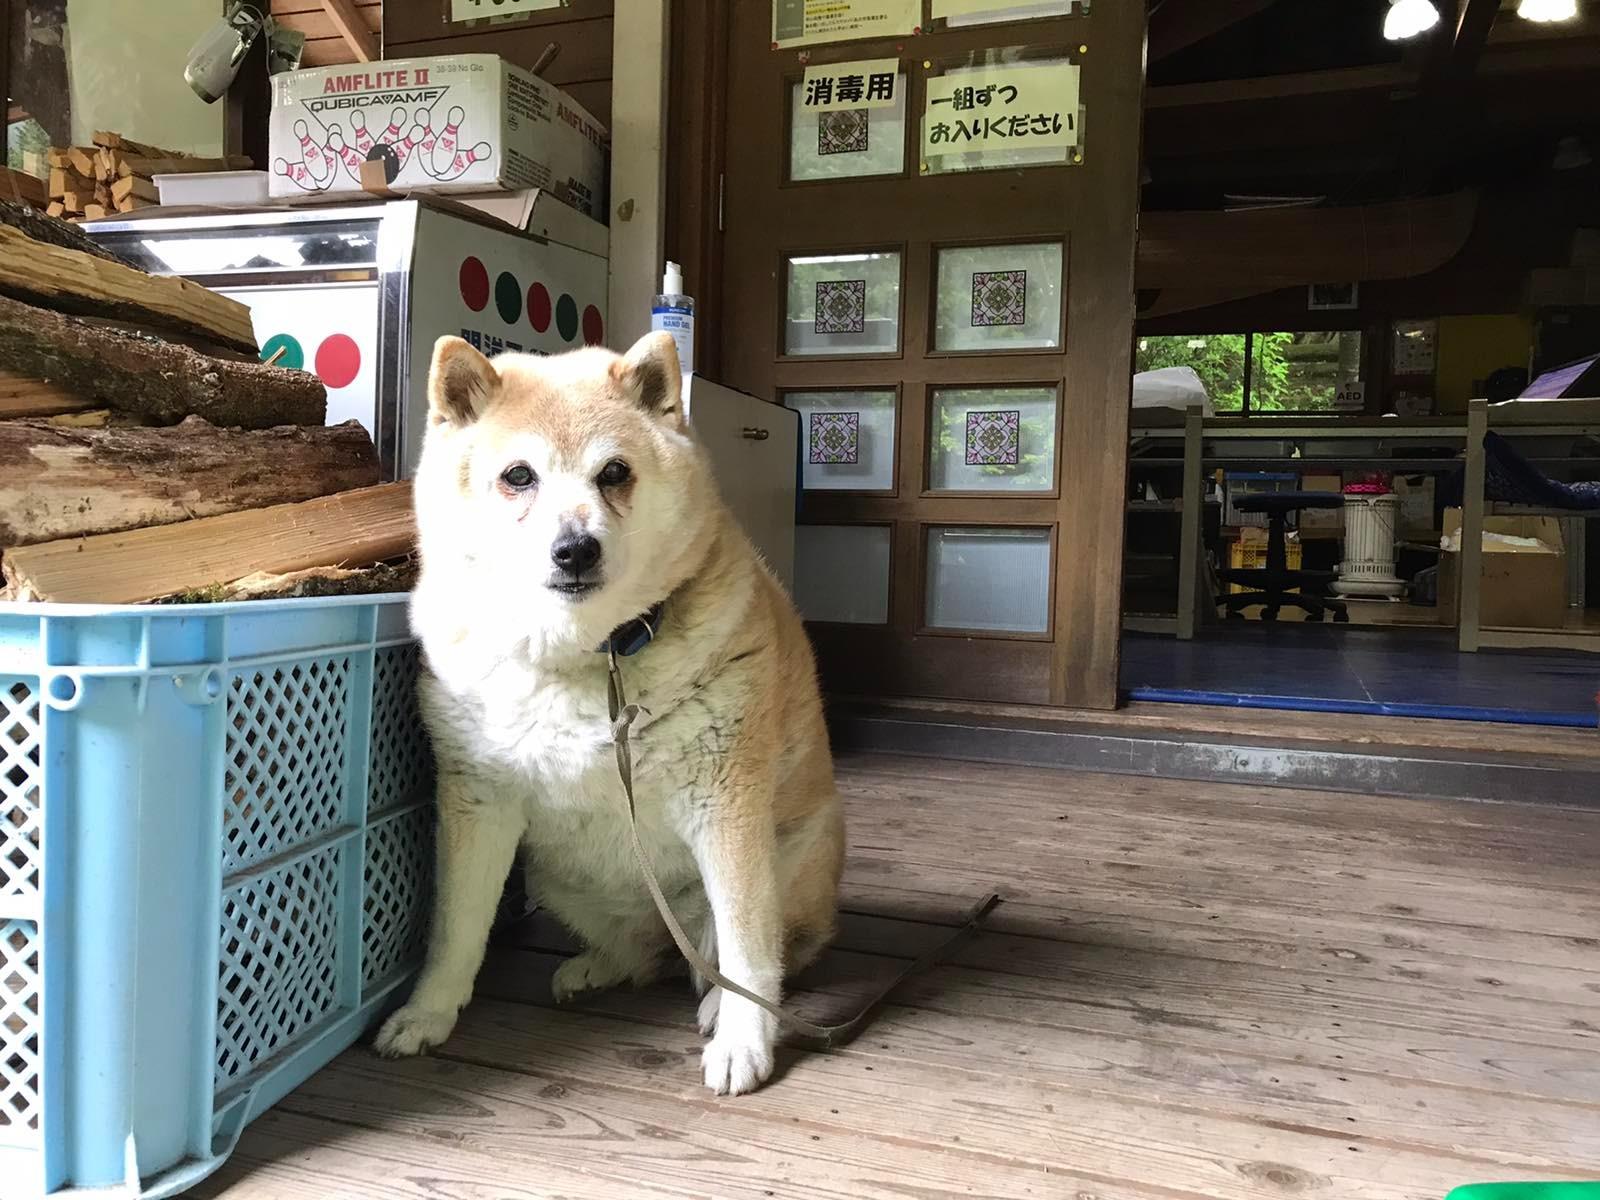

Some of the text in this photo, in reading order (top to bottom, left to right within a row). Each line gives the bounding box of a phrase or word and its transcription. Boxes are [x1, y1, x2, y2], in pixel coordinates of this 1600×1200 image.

[323, 68, 430, 94] AMFLITE II
[804, 72, 894, 106] 消毒用
[930, 84, 1018, 111] 一組ずつ
[556, 101, 599, 145] AMFLITE
[929, 112, 1074, 145] お入りください
[663, 320, 690, 329] HAND GEL
[1337, 391, 1361, 401] AED
